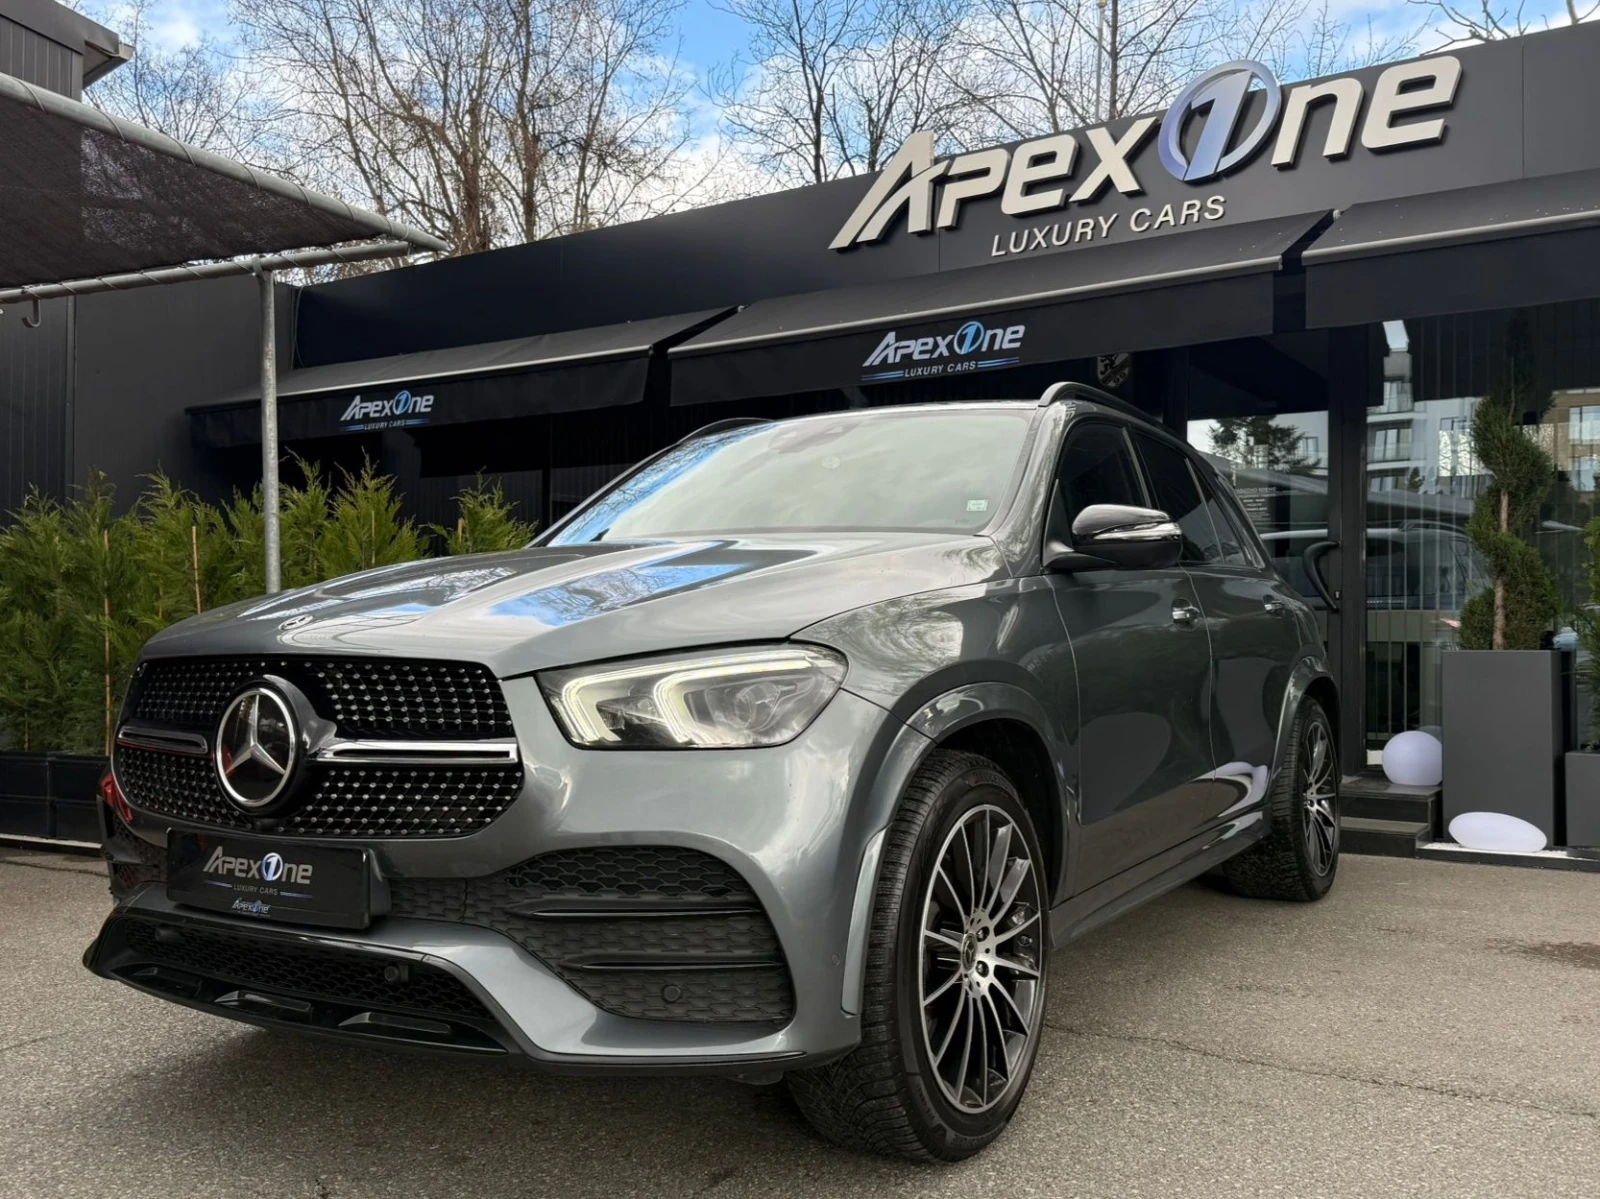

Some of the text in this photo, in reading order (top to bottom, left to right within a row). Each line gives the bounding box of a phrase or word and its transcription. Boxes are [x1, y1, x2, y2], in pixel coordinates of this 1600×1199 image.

[991, 195, 1226, 257] LUXURY CARS
[904, 361, 976, 377] LUXURY CARS
[364, 420, 406, 430] LUXURY CARS
[233, 884, 278, 896] LUXURY CARS
